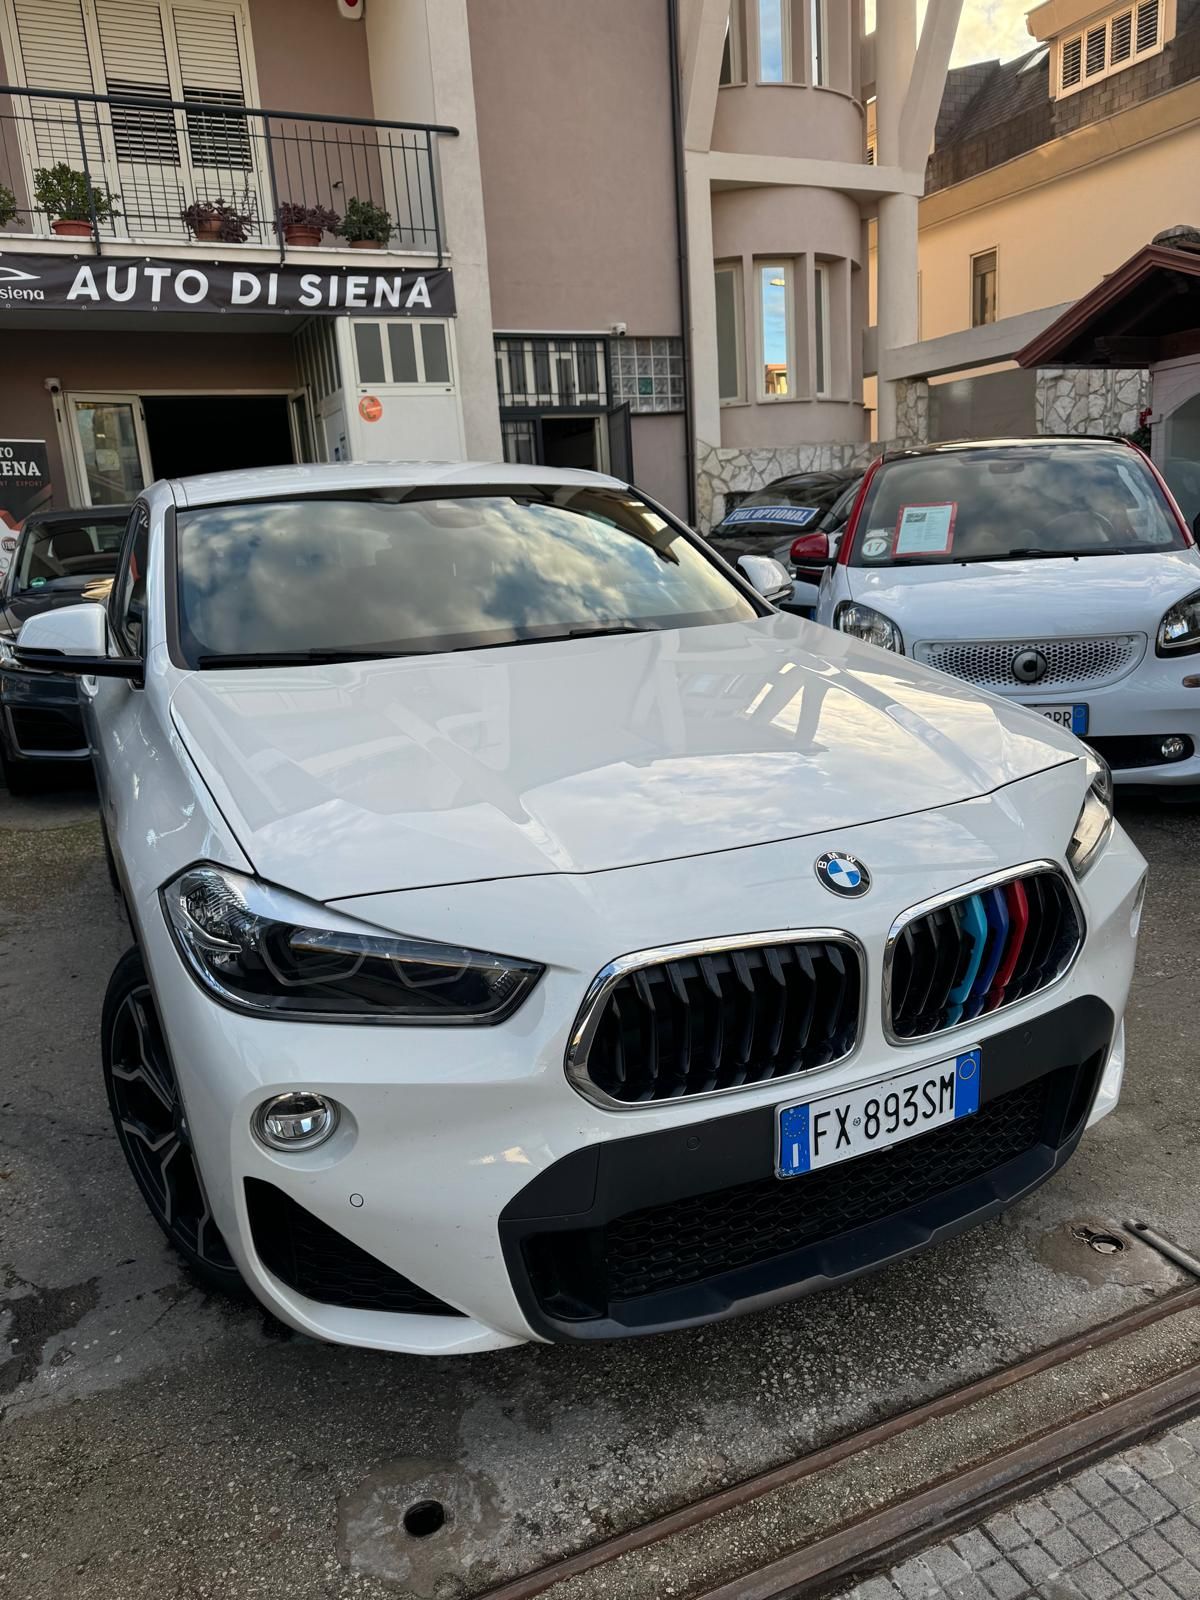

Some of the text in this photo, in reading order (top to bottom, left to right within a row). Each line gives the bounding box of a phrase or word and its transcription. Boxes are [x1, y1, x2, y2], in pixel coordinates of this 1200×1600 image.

[0, 286, 44, 300] siena
[66, 265, 432, 308] AUTO DI SIENA
[0, 461, 41, 476] ENA
[730, 508, 809, 522] FULL OPTIONAL
[866, 542, 881, 553] 17
[818, 852, 856, 869] BMW
[813, 1071, 955, 1156] FX 893SM
